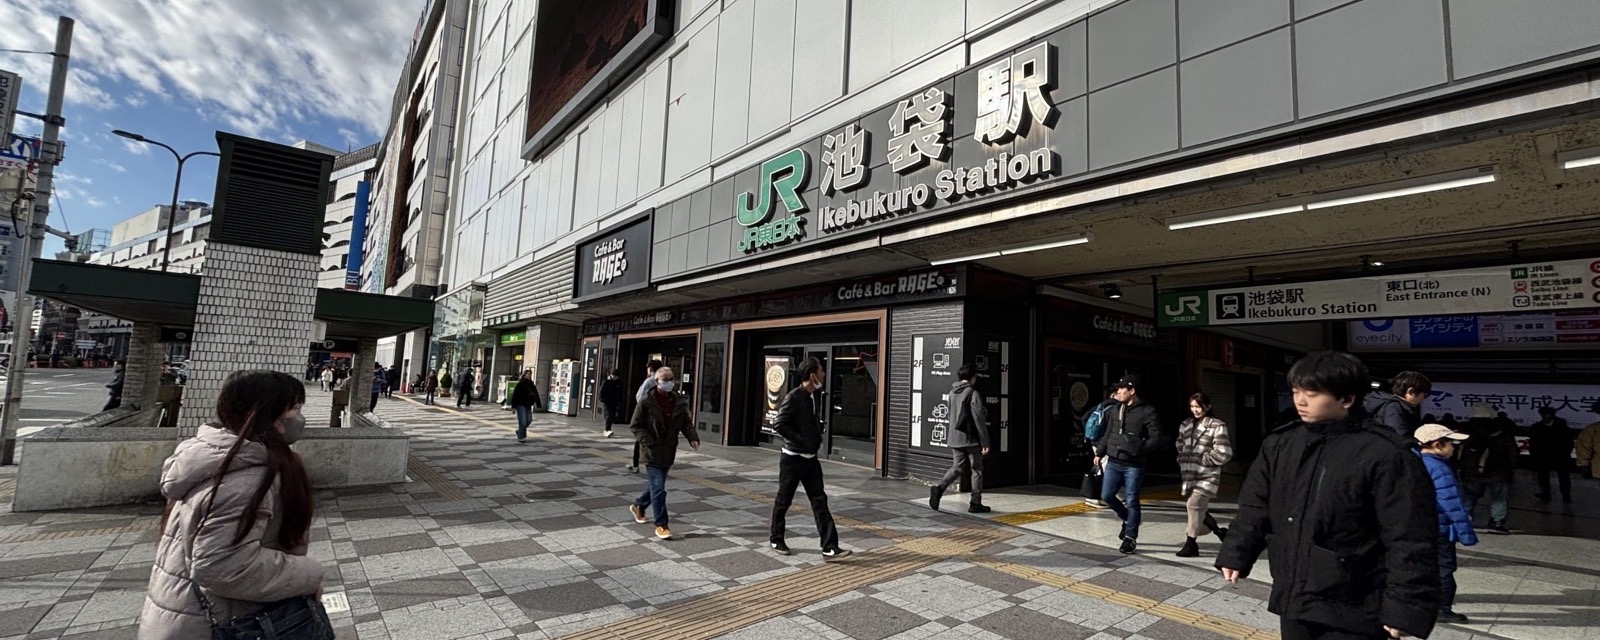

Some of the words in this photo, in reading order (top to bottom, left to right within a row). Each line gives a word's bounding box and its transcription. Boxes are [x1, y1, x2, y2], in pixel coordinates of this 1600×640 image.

[820, 41, 1051, 196] 池袋駅
[737, 148, 806, 226] JR
[818, 182, 928, 231] Ikebukuro
[935, 147, 1051, 200] Station
[737, 214, 801, 252] JR東日本
[592, 251, 624, 286] RAGE
[837, 283, 863, 300] Café
[873, 281, 897, 296] Bar
[897, 271, 939, 294] RAGE
[1386, 279, 1440, 292] 東口(北)
[1386, 293, 1411, 302] East
[1414, 289, 1468, 301] Entrance
[1471, 286, 1491, 297] (N)
[1164, 295, 1201, 316] JR
[1248, 288, 1304, 306] 池袋駅
[1248, 305, 1316, 319] Ikebukuro
[1321, 301, 1377, 315] Station
[1355, 333, 1403, 344] eyecity
[1413, 323, 1475, 334] アイシティ
